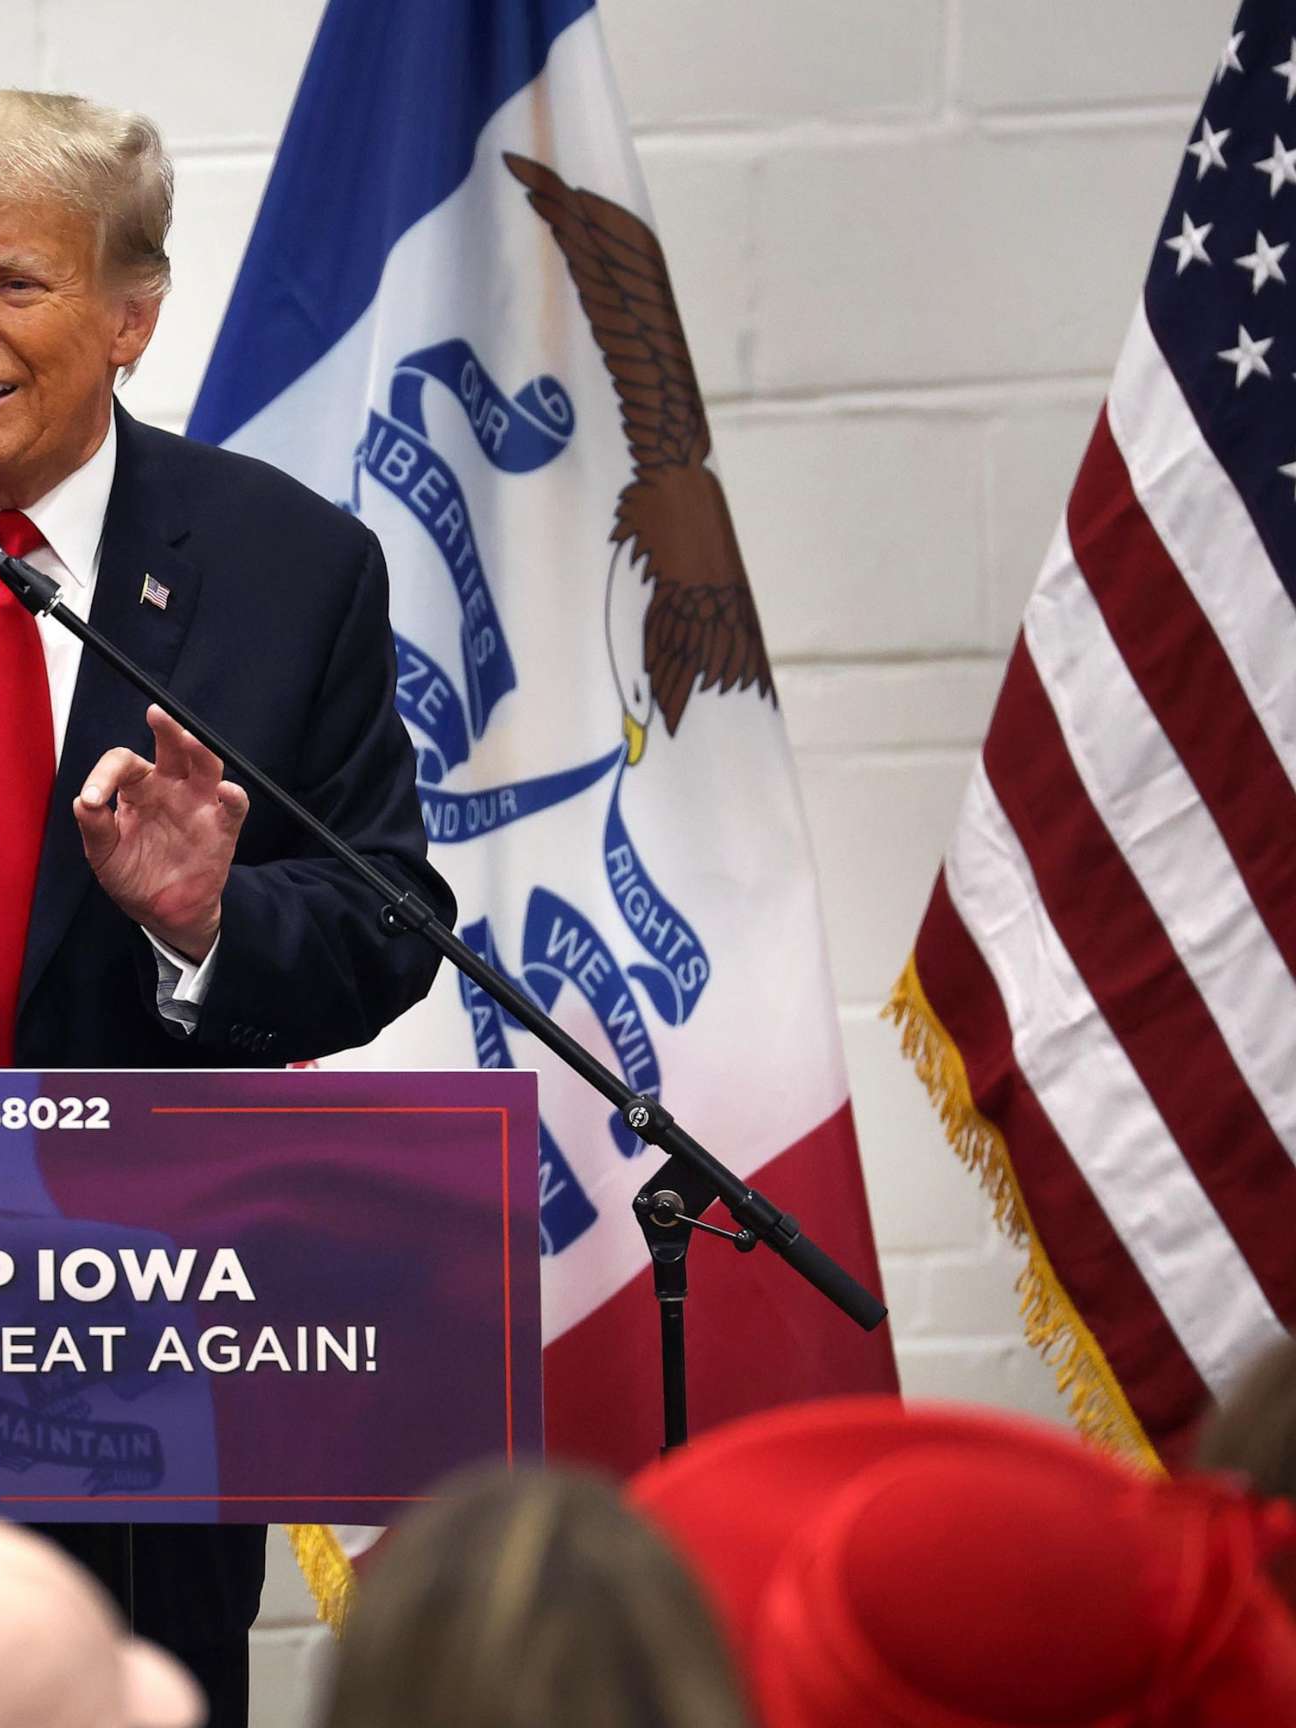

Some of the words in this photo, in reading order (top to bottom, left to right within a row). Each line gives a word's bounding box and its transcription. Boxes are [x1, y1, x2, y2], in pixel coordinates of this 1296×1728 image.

[460, 360, 510, 454] OUR
[368, 427, 496, 667] IBERTIES
[421, 801, 461, 839] ND
[465, 788, 518, 833] OUR
[545, 916, 612, 998] WE
[607, 844, 707, 992] RIGHTS
[38, 1247, 256, 1302] IOWA
[147, 1325, 378, 1373] AGAIN!
